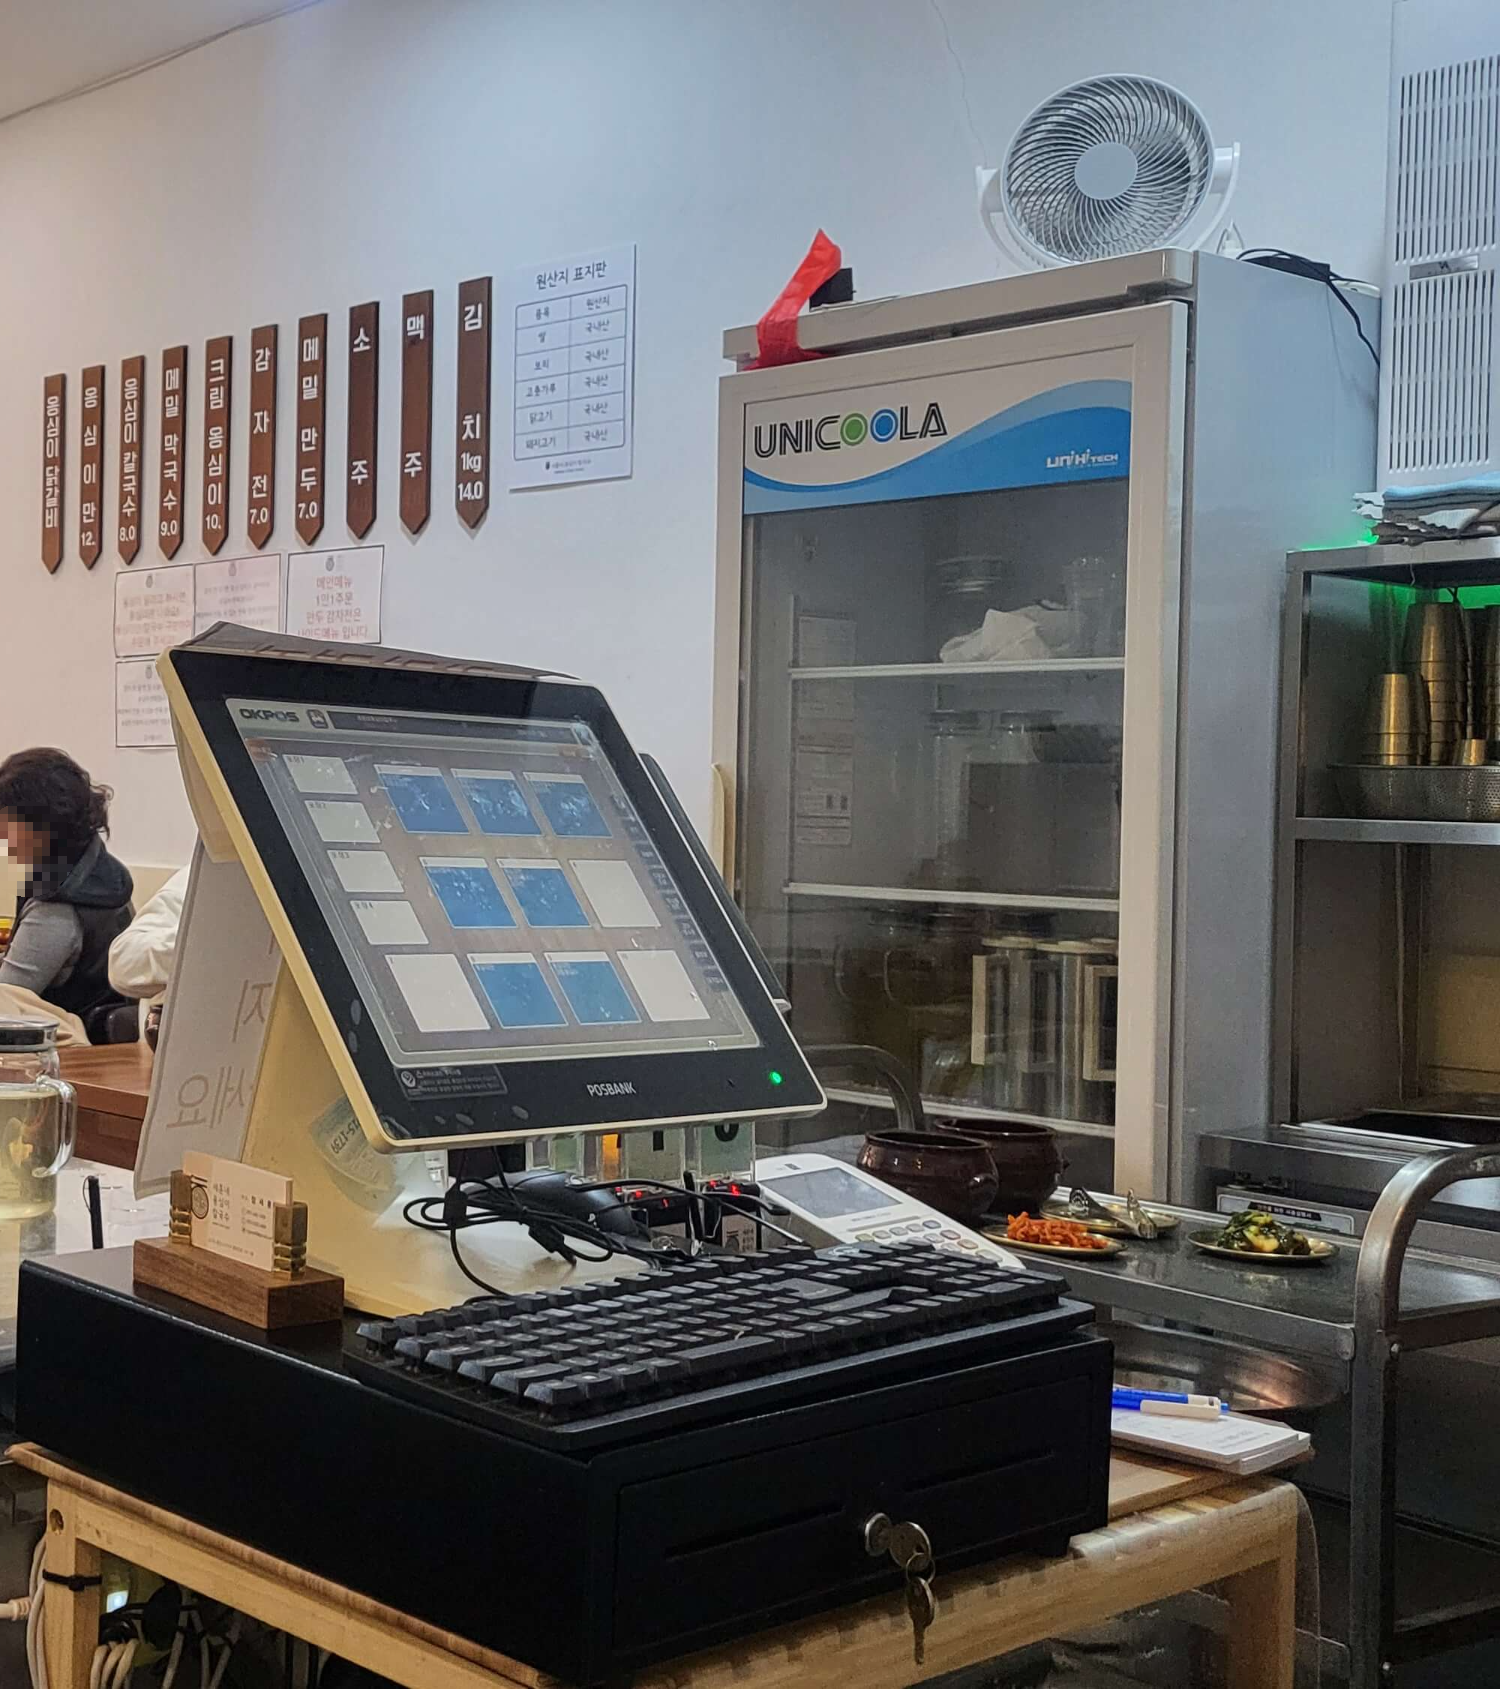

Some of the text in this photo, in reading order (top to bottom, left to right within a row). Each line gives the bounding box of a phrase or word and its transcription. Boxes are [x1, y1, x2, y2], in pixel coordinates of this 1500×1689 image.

[536, 261, 607, 290] 원산지 표지판
[586, 319, 610, 332] 국내산
[585, 348, 609, 362] 국내산
[584, 374, 608, 388] 국내산
[583, 402, 608, 415] 국내산
[250, 347, 271, 524] 감자전 7.0
[298, 337, 319, 519] 메밀 만두 7.0
[583, 429, 608, 442] 국내산
[754, 402, 947, 458] UNICOOLA
[160, 368, 180, 536] 메밀 막국수 9.0
[205, 358, 224, 529] 크림 옹심이 10.
[45, 396, 60, 528] 옹심이 닭갈비
[119, 378, 137, 542] 옹심이 칼국수 8.0
[460, 452, 481, 473] 1kg
[458, 481, 483, 501] 14.0
[239, 708, 300, 722] OKPOS
[586, 1081, 636, 1097] POSBANK
